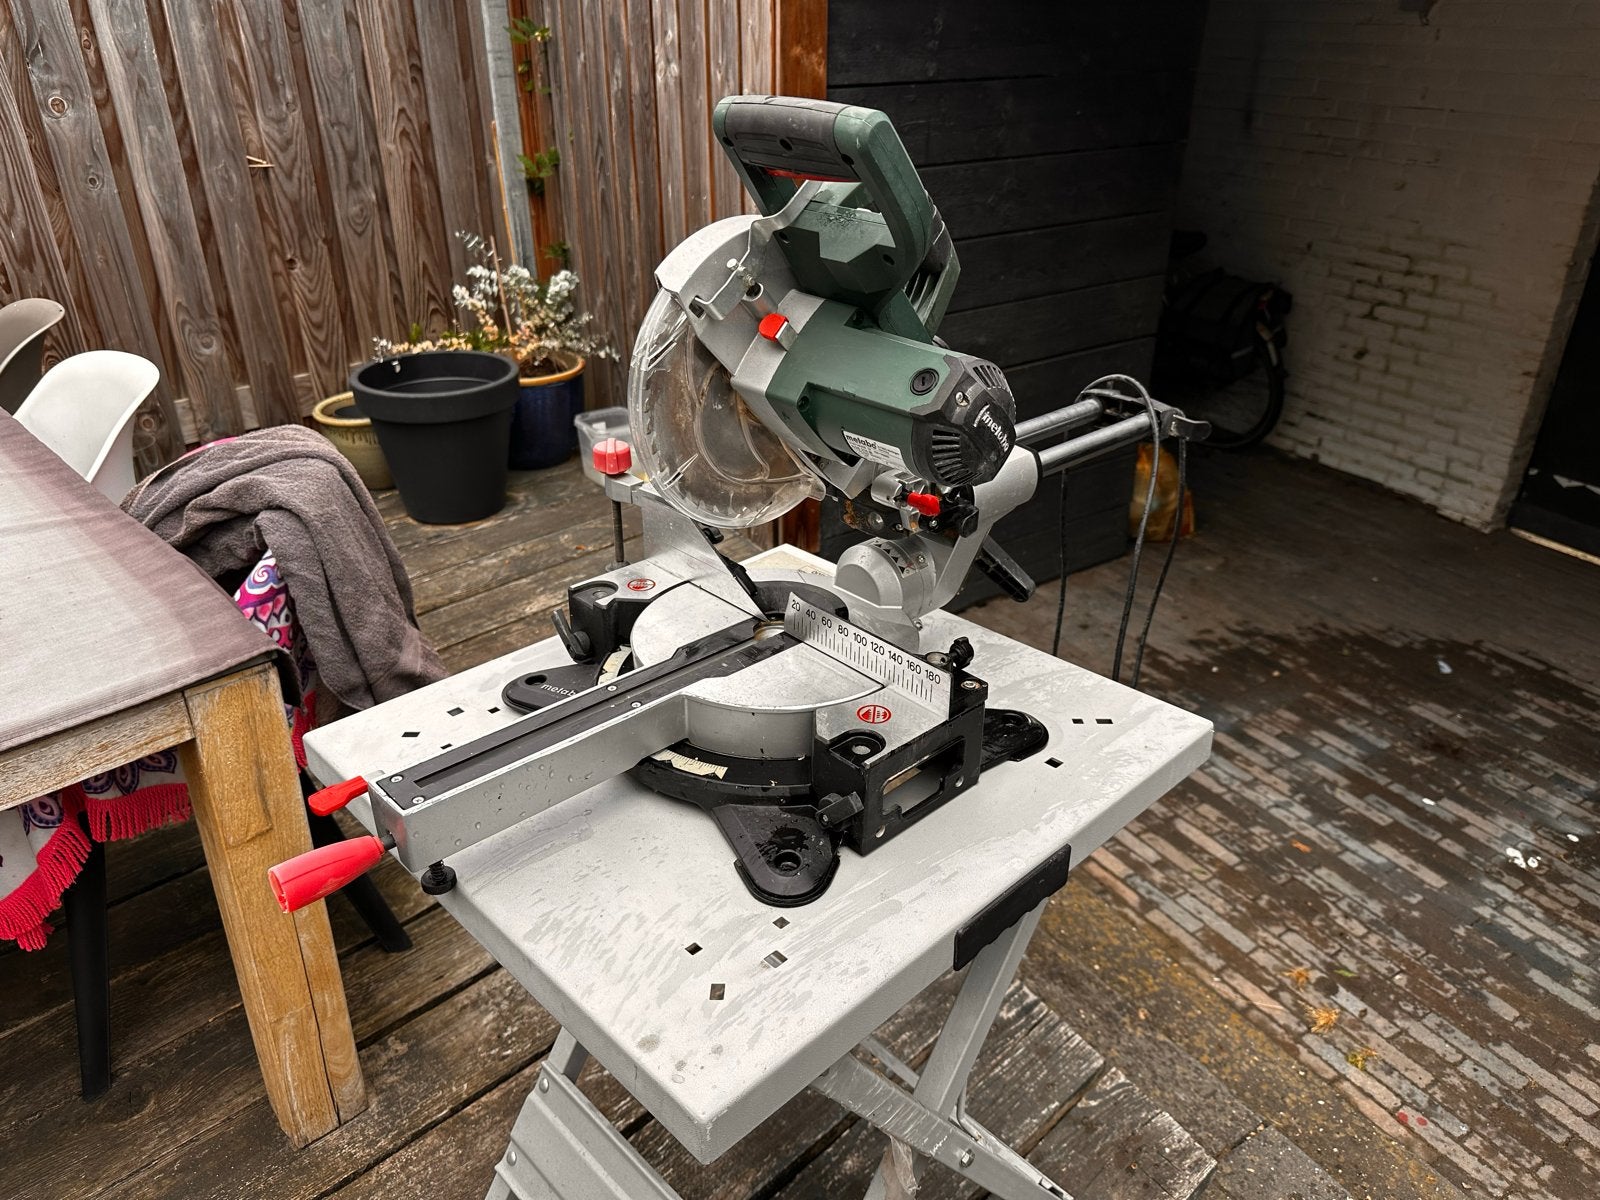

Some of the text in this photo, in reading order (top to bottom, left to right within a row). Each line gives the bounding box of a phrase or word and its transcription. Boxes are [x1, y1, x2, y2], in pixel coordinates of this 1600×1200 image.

[791, 599, 941, 685] 20 40 60 80 100 120 140 160 180
[540, 684, 576, 697] metab
